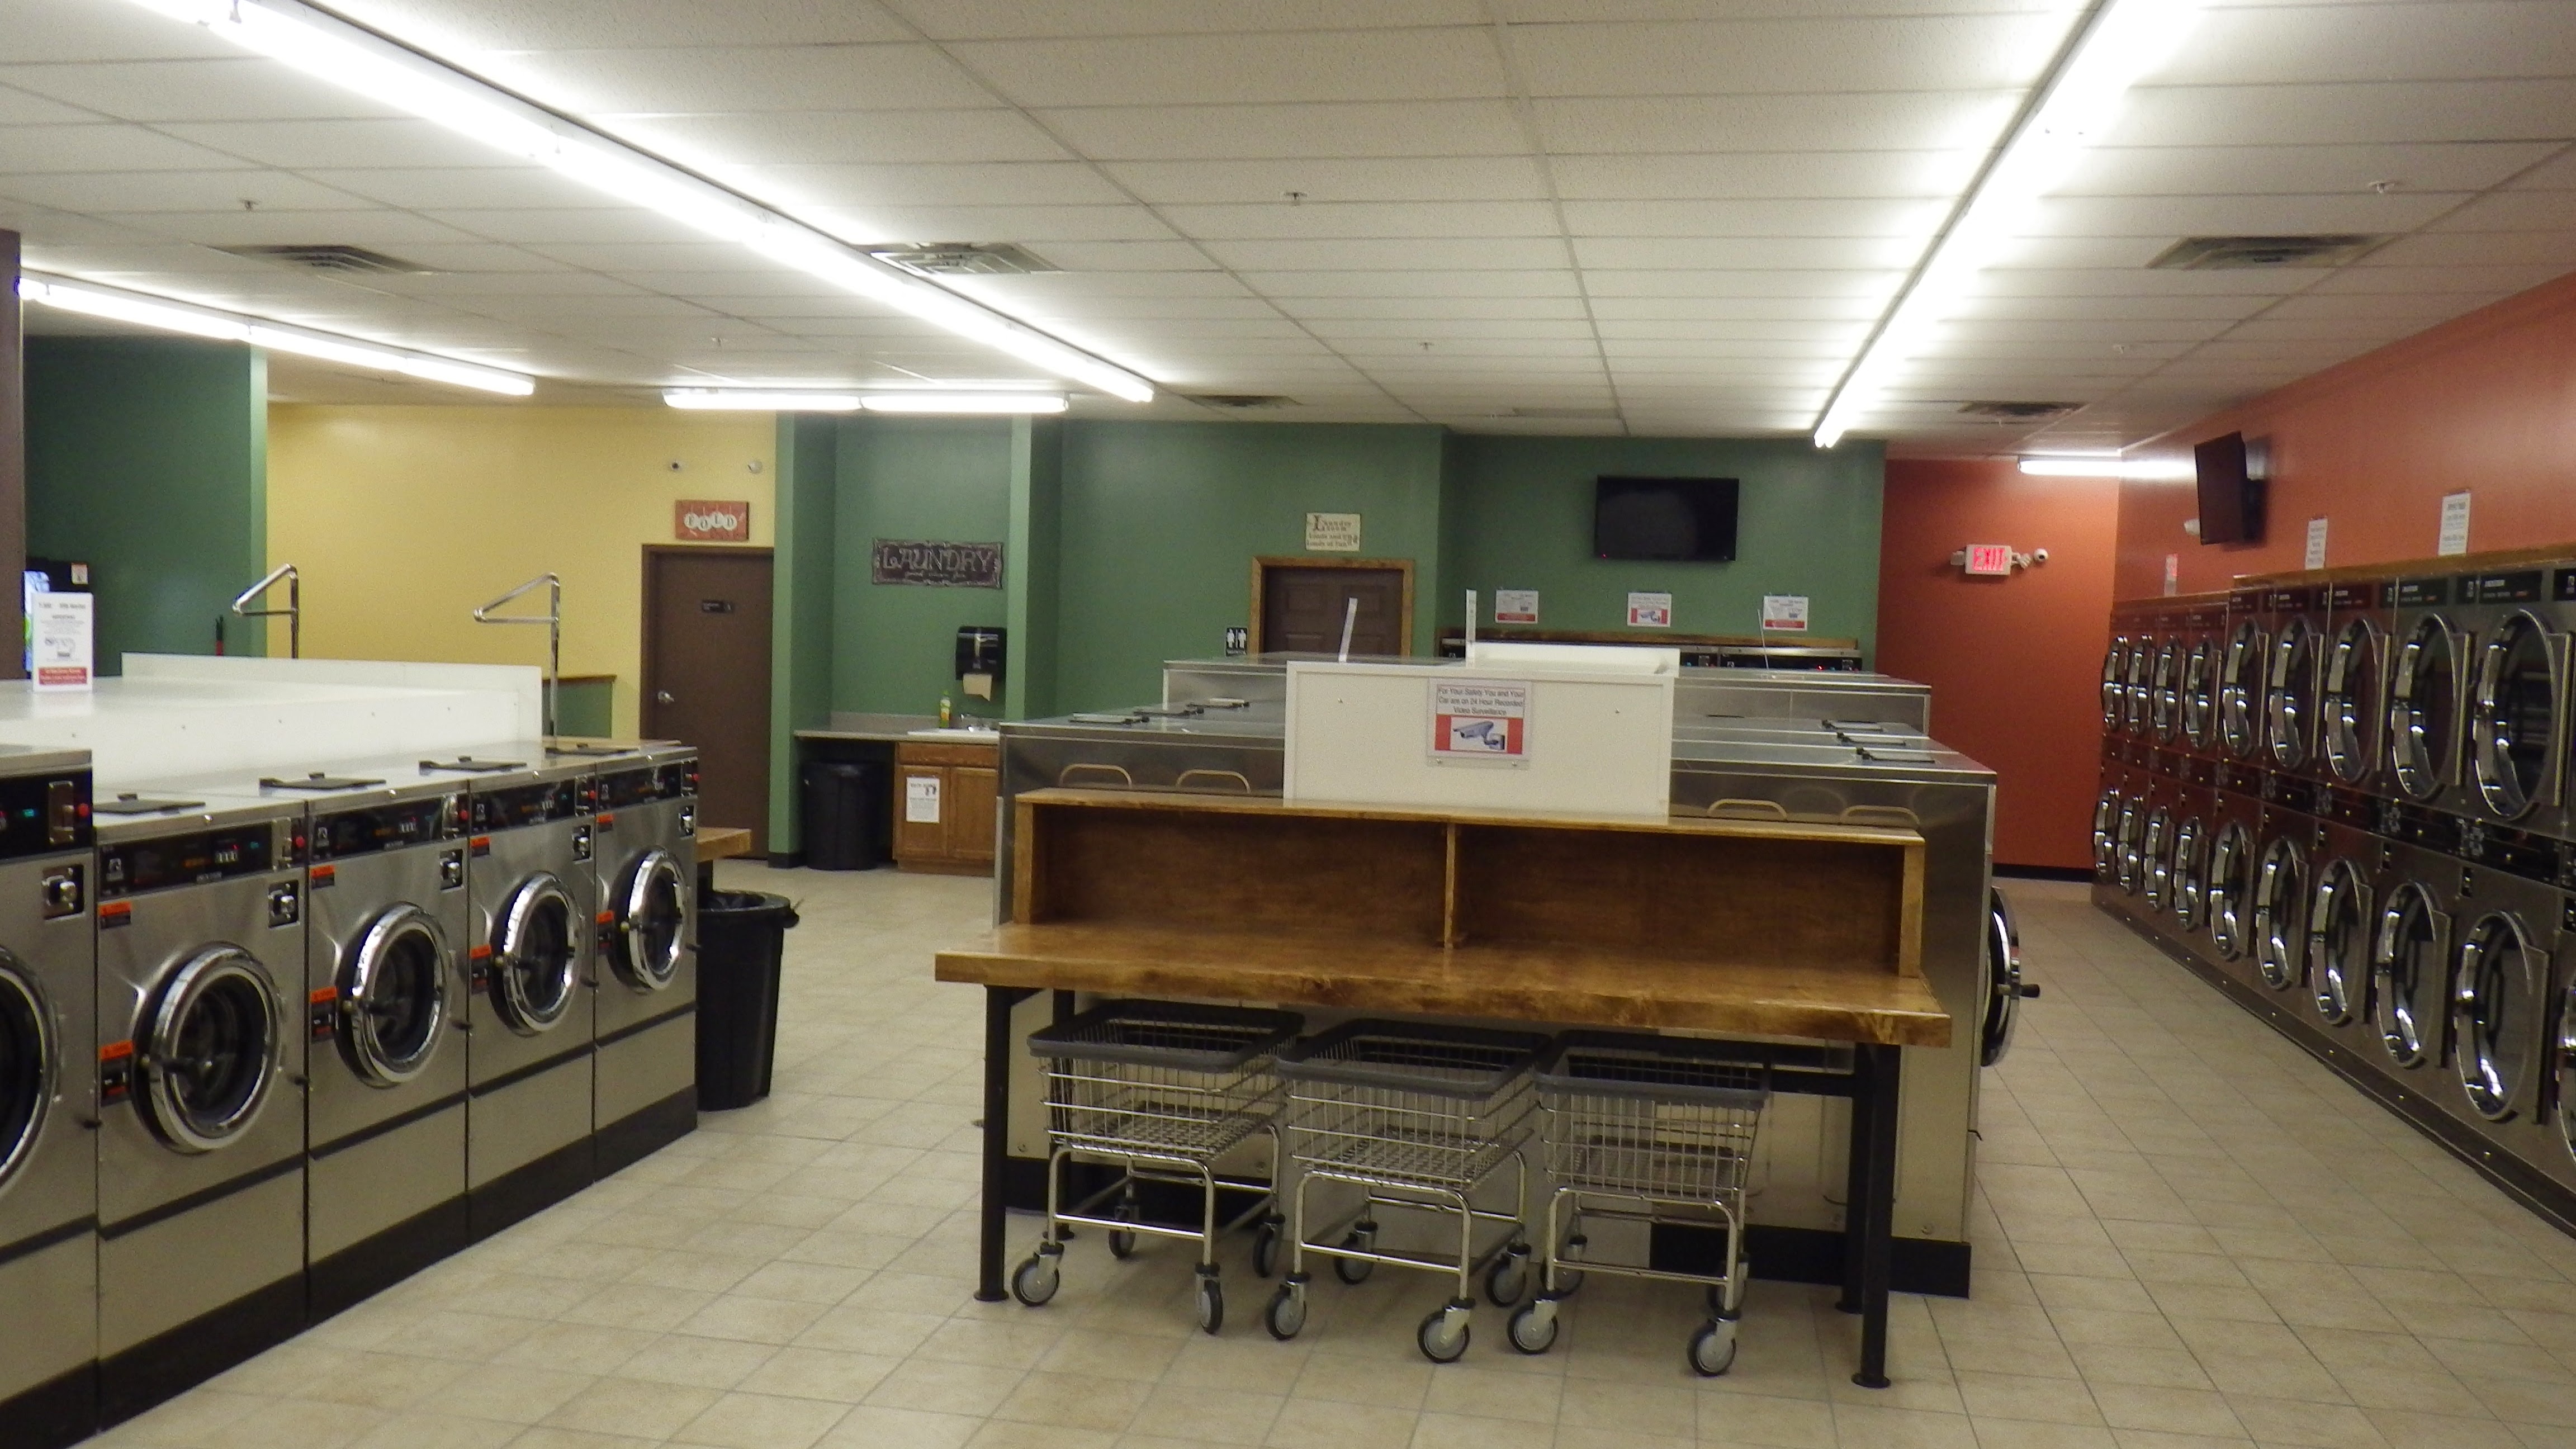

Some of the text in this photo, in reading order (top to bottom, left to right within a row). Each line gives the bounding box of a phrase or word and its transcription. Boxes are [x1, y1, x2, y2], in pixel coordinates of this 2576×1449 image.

[688, 514, 734, 529] FOLD
[882, 546, 994, 574] LAUNDRY
[1972, 547, 2005, 571] EXIT
